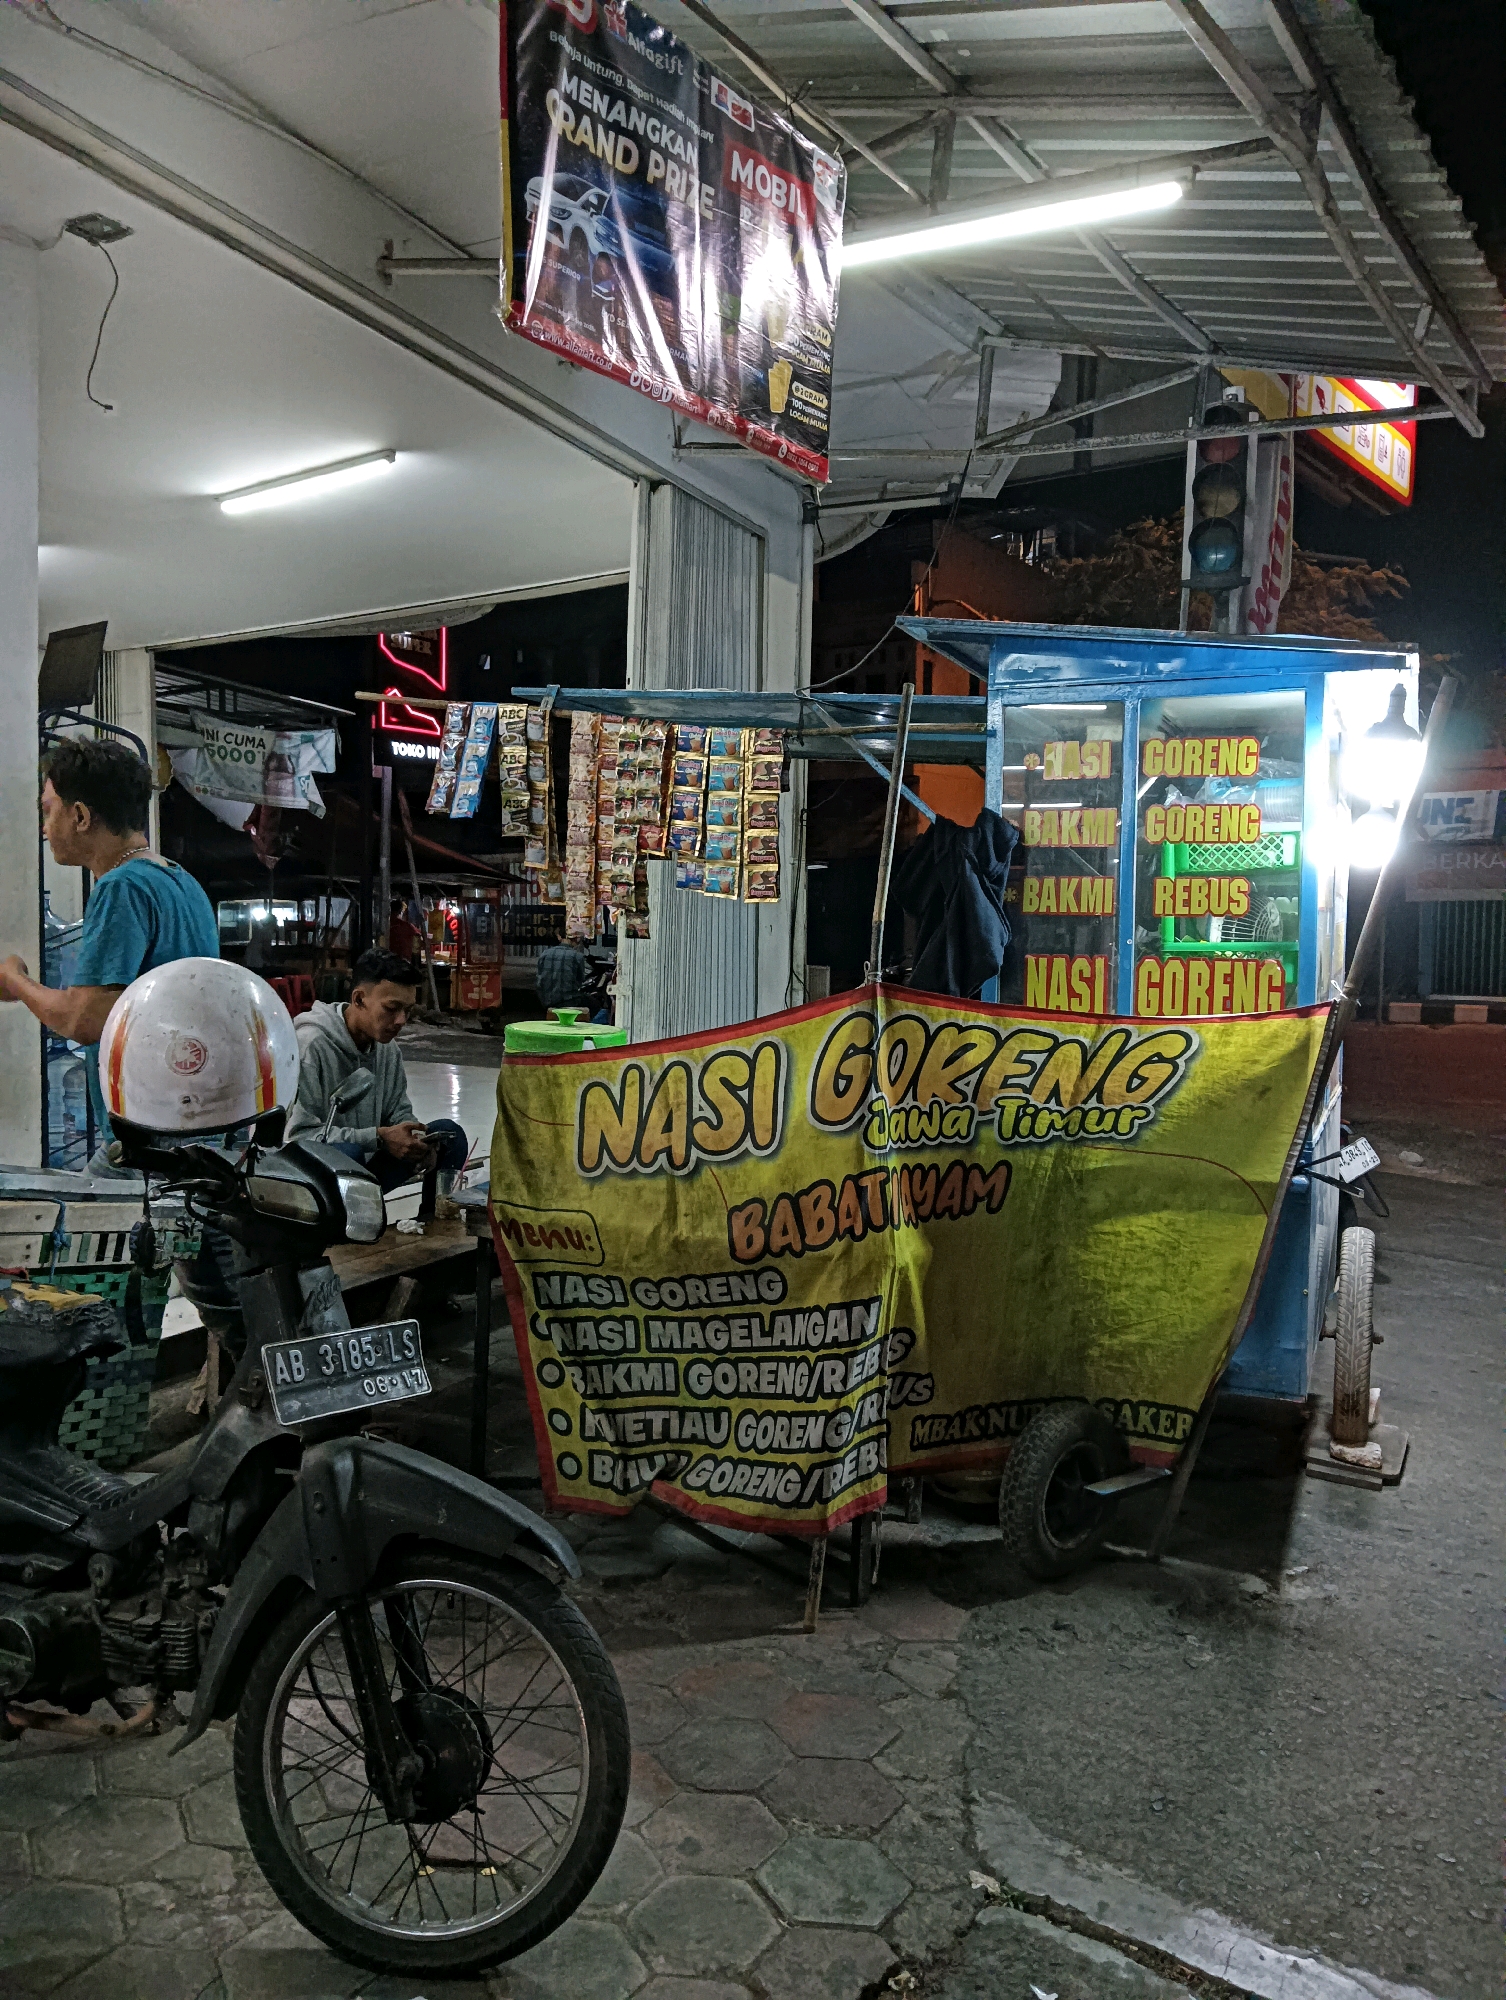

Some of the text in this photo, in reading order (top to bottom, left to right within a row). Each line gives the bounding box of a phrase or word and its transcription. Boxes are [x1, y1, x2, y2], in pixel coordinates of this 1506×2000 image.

[562, 67, 699, 169] MENANGKAN
[646, 149, 715, 221] PRIZE
[731, 150, 807, 220] MOBIL
[500, 708, 524, 720] ABC
[224, 732, 266, 750] CUMA
[501, 753, 525, 765] ABC
[1044, 737, 1259, 780] NASI GORENG
[503, 798, 526, 809] ABC
[1023, 804, 1261, 847] BAKMI GORENG
[1022, 876, 1250, 917] BAKMI REBUS
[1025, 954, 1285, 1016] NASI GORENG
[577, 1011, 1193, 1173] NASI GORENG
[862, 1095, 1150, 1149] Jawa Timur
[533, 1267, 787, 1309] NASI GORENG
[550, 1296, 882, 1353] NASI MAGELANGAN
[275, 1329, 416, 1386] AB 3185 LS
[566, 1358, 680, 1399] BAKMI
